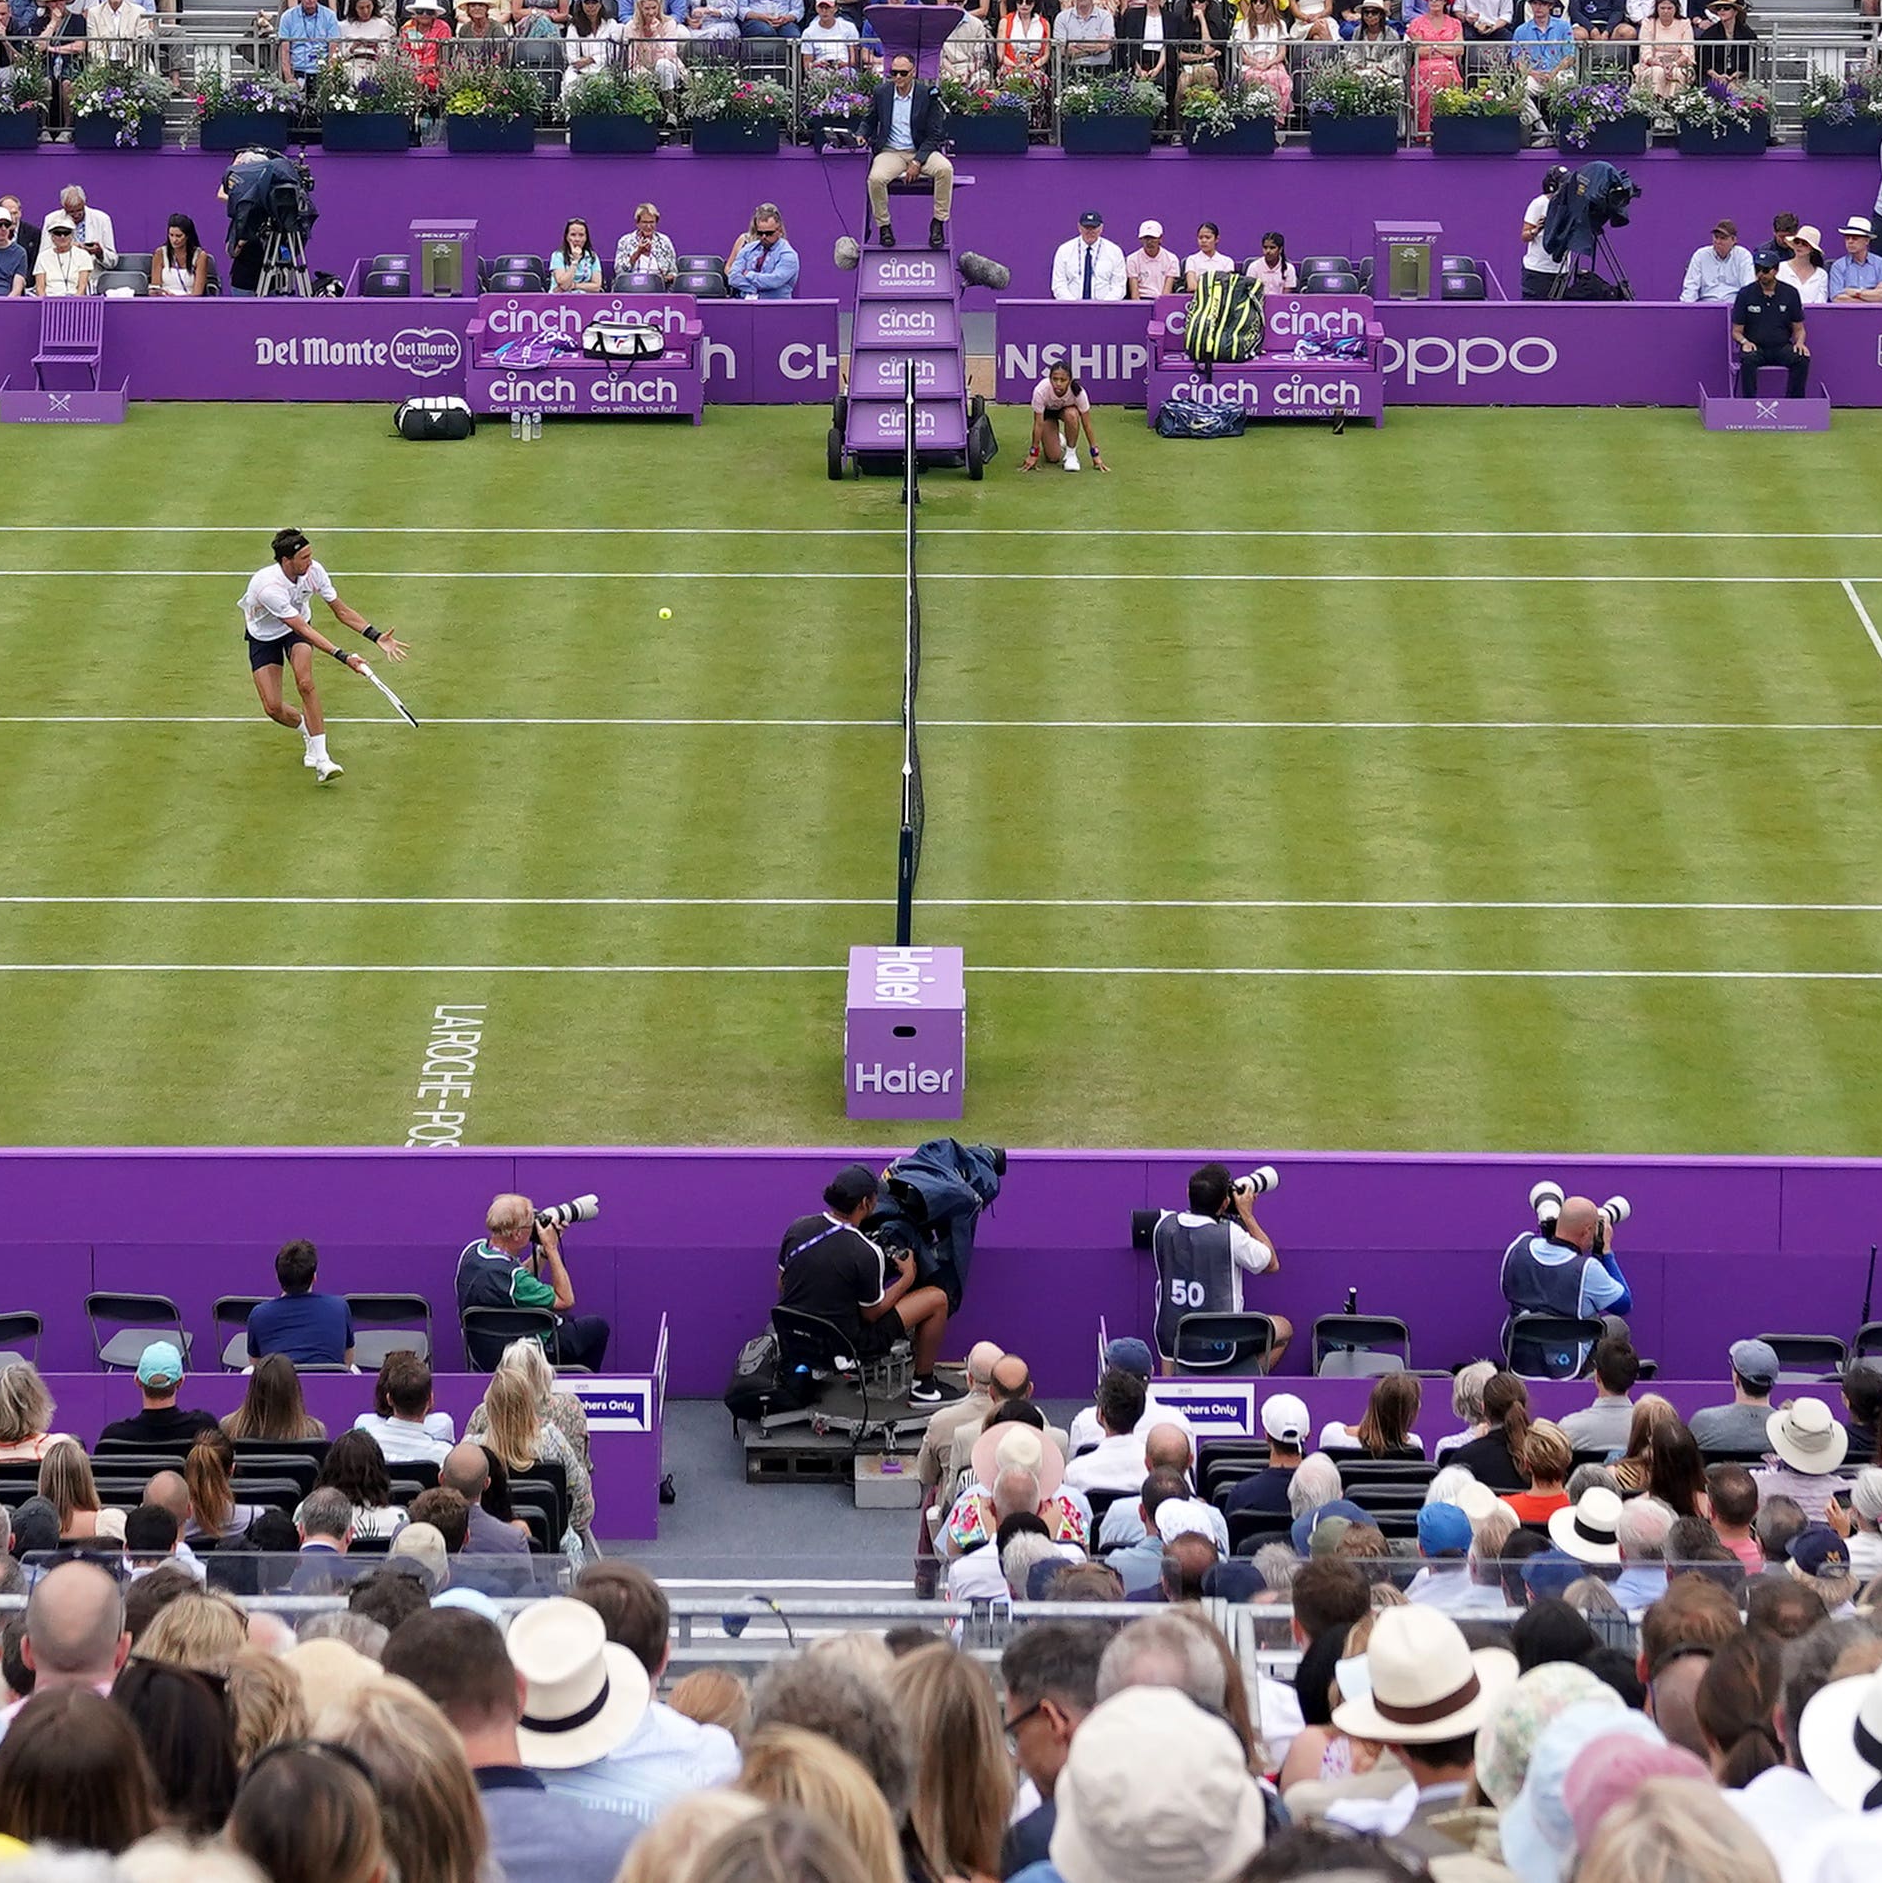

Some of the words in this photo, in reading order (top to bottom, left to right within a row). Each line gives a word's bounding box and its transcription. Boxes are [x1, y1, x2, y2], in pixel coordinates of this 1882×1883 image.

[879, 258, 935, 278] cinch
[488, 299, 582, 333] cinch
[878, 307, 935, 328] cinch
[1270, 301, 1364, 335] cinch
[255, 337, 298, 365] Del
[302, 337, 388, 366] Monte
[396, 342, 417, 356] Del
[417, 342, 457, 356] Monte
[489, 371, 575, 402] cinch
[590, 371, 677, 402] cinch
[1171, 374, 1259, 405] cinch
[1273, 374, 1360, 405] cinch
[490, 405, 508, 413] Cars
[591, 405, 610, 413] Cars
[613, 404, 643, 413] without
[646, 405, 658, 413] the
[1273, 407, 1294, 416] Cars
[1295, 407, 1327, 416] without
[875, 947, 936, 1005] Haier
[856, 1062, 953, 1093] Haier
[1171, 1279, 1205, 1308] 50
[608, 1400, 635, 1413] Only
[1211, 1404, 1237, 1417] Only
